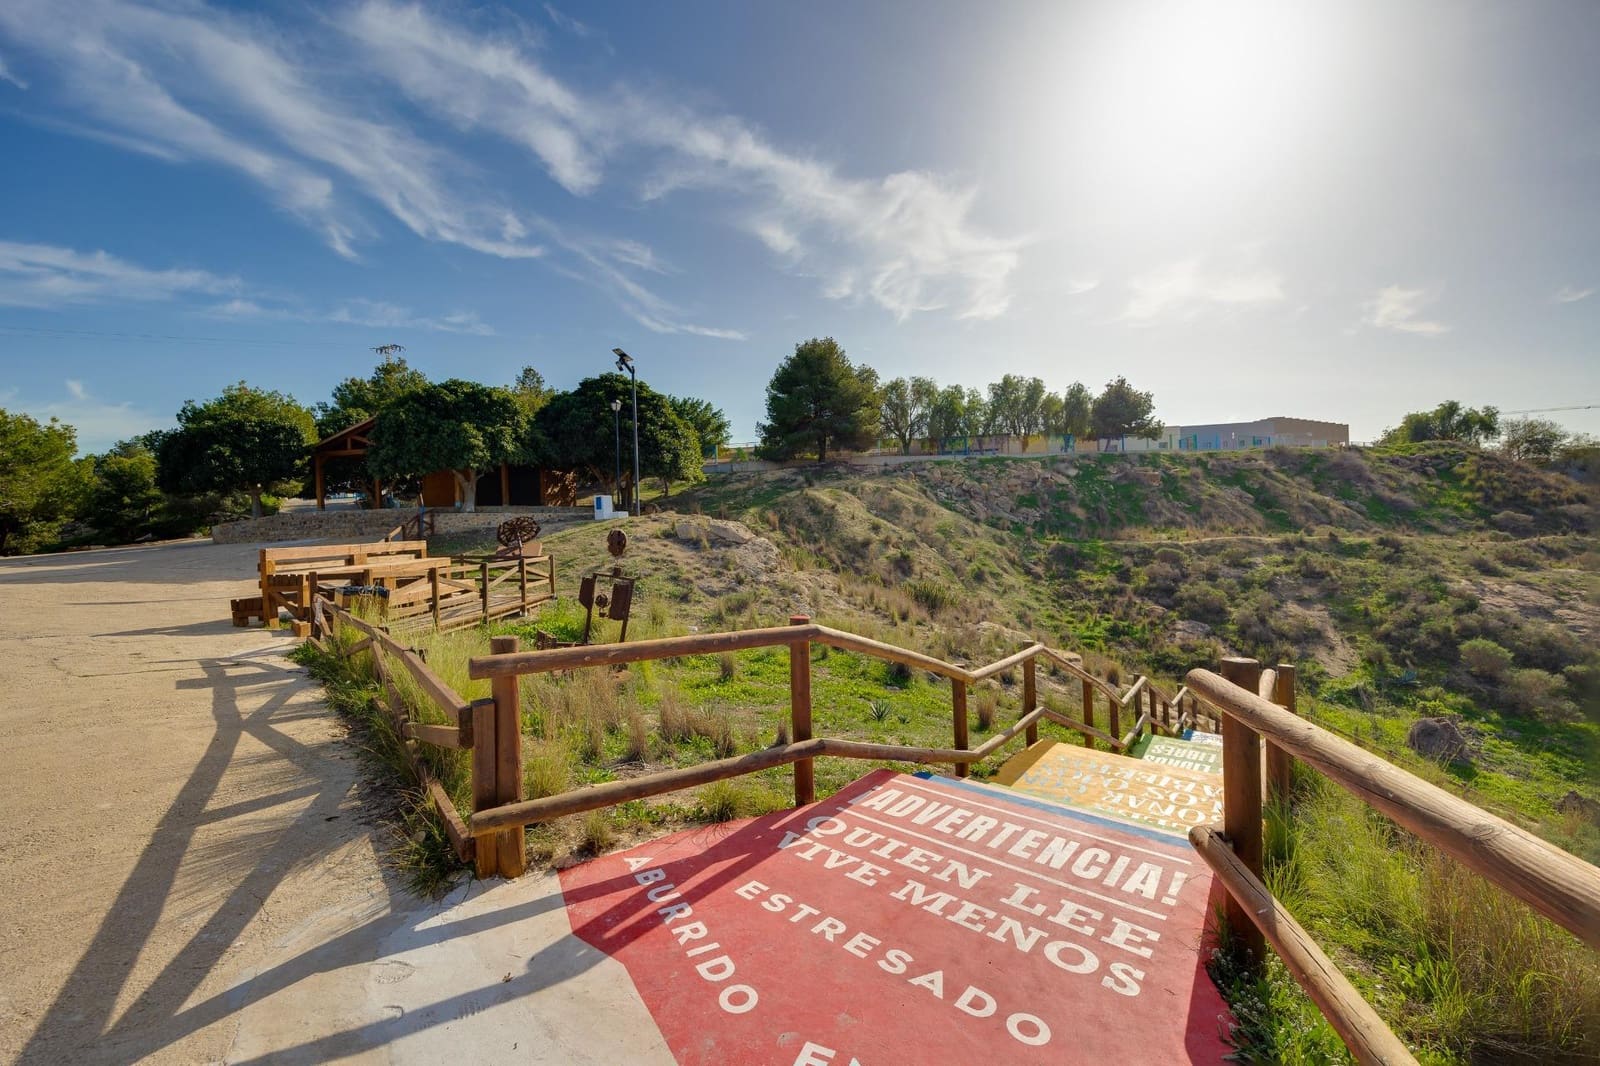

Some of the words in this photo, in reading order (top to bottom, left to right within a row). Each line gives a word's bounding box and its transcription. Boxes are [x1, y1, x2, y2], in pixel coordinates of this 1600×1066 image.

[624, 856, 759, 1014] ABURRIDO
[736, 881, 1051, 1046] ESTRESADO
[777, 831, 891, 886] VIVE
[889, 880, 1146, 997] MENOS
[805, 816, 991, 889] QUIEN
[1001, 883, 1161, 959] LEE
